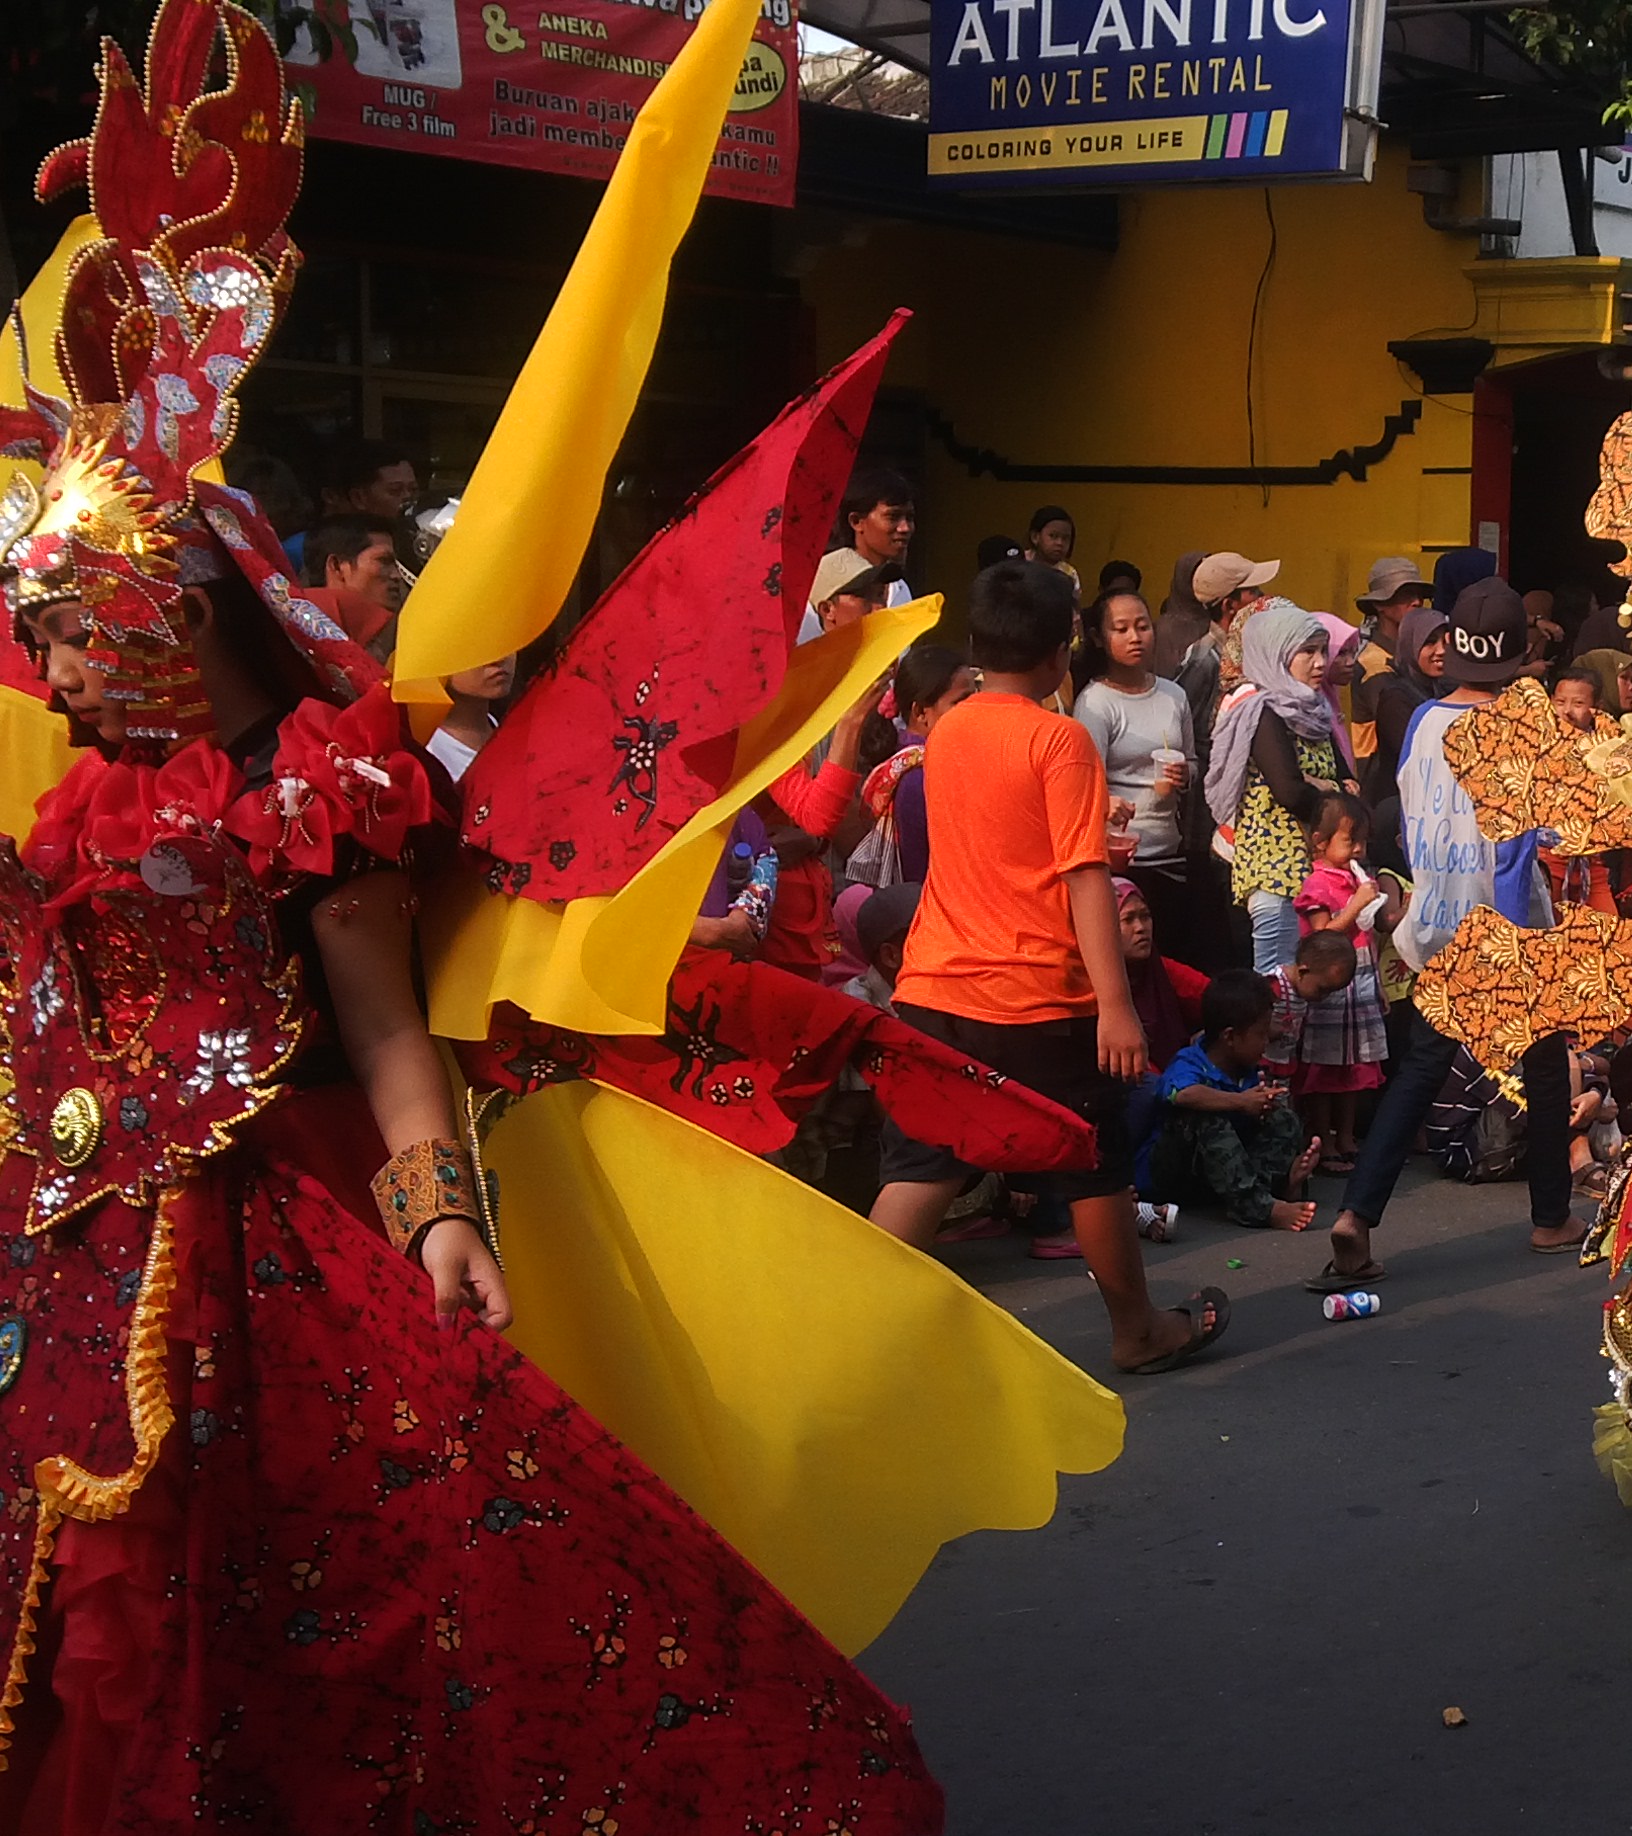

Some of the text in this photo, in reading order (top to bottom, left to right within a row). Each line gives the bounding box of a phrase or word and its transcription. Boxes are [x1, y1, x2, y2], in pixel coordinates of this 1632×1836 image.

[539, 12, 608, 40] ANEKA
[947, 0, 1327, 66] ATLANTIC
[541, 41, 673, 79] MERCHANDIS
[740, 56, 762, 77] pa
[383, 84, 426, 108] MUG
[735, 72, 778, 95] undi
[990, 54, 1272, 110] MOVIE RENTAL
[362, 106, 455, 137] Free 3 film
[495, 79, 776, 146] Buruan ajak kamu
[490, 111, 536, 136] jadi
[543, 124, 627, 150] membe
[709, 150, 760, 171] antic
[947, 131, 1183, 161] COLORING YOUR LIFE
[1455, 627, 1505, 658] BOY
